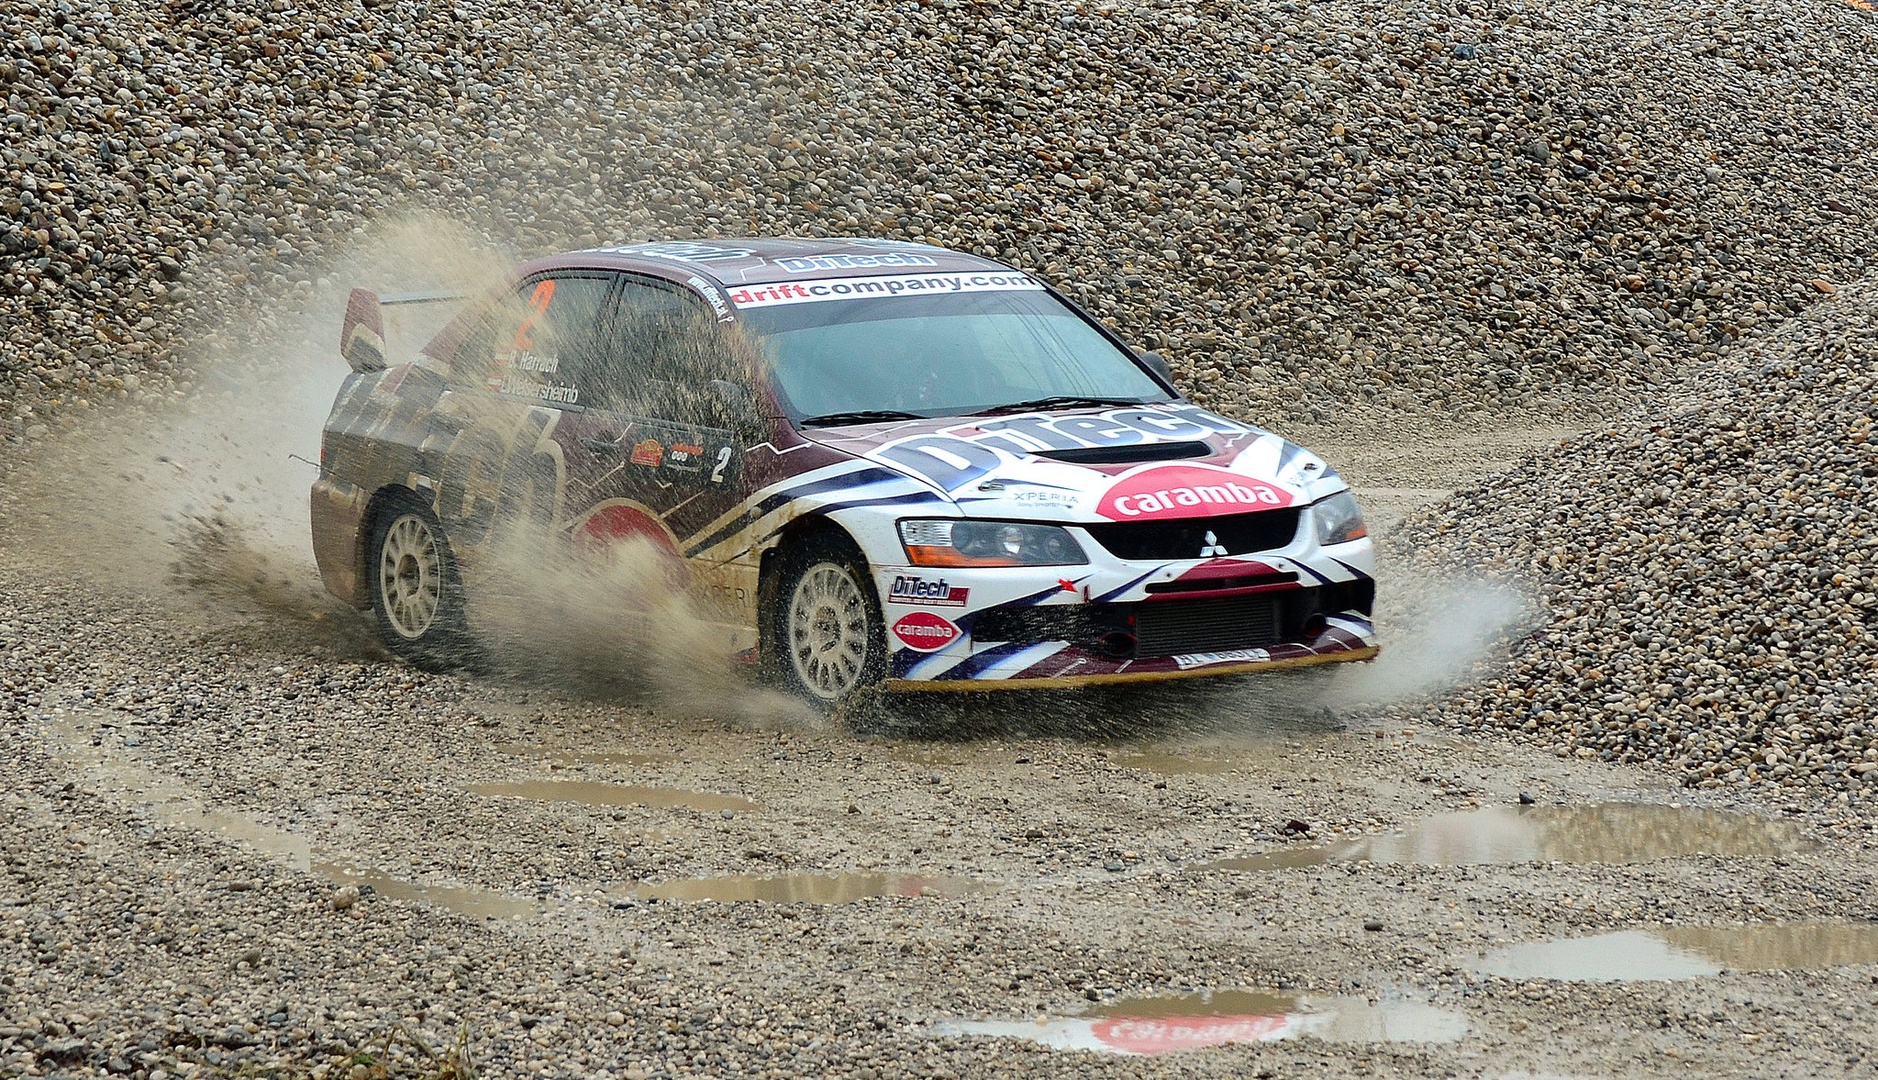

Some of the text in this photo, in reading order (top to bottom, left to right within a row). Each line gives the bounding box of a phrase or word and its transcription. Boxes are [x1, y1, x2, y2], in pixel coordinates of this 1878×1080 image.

[774, 252, 938, 273] DiTech
[731, 274, 1036, 304] driftcompany.com
[514, 279, 556, 350] 2
[519, 351, 559, 373] Harrach
[711, 447, 732, 482] 2
[1013, 492, 1079, 503] XPERIA
[1113, 482, 1281, 516] caramba
[893, 576, 949, 597] DiTech
[896, 624, 953, 638] caramba
